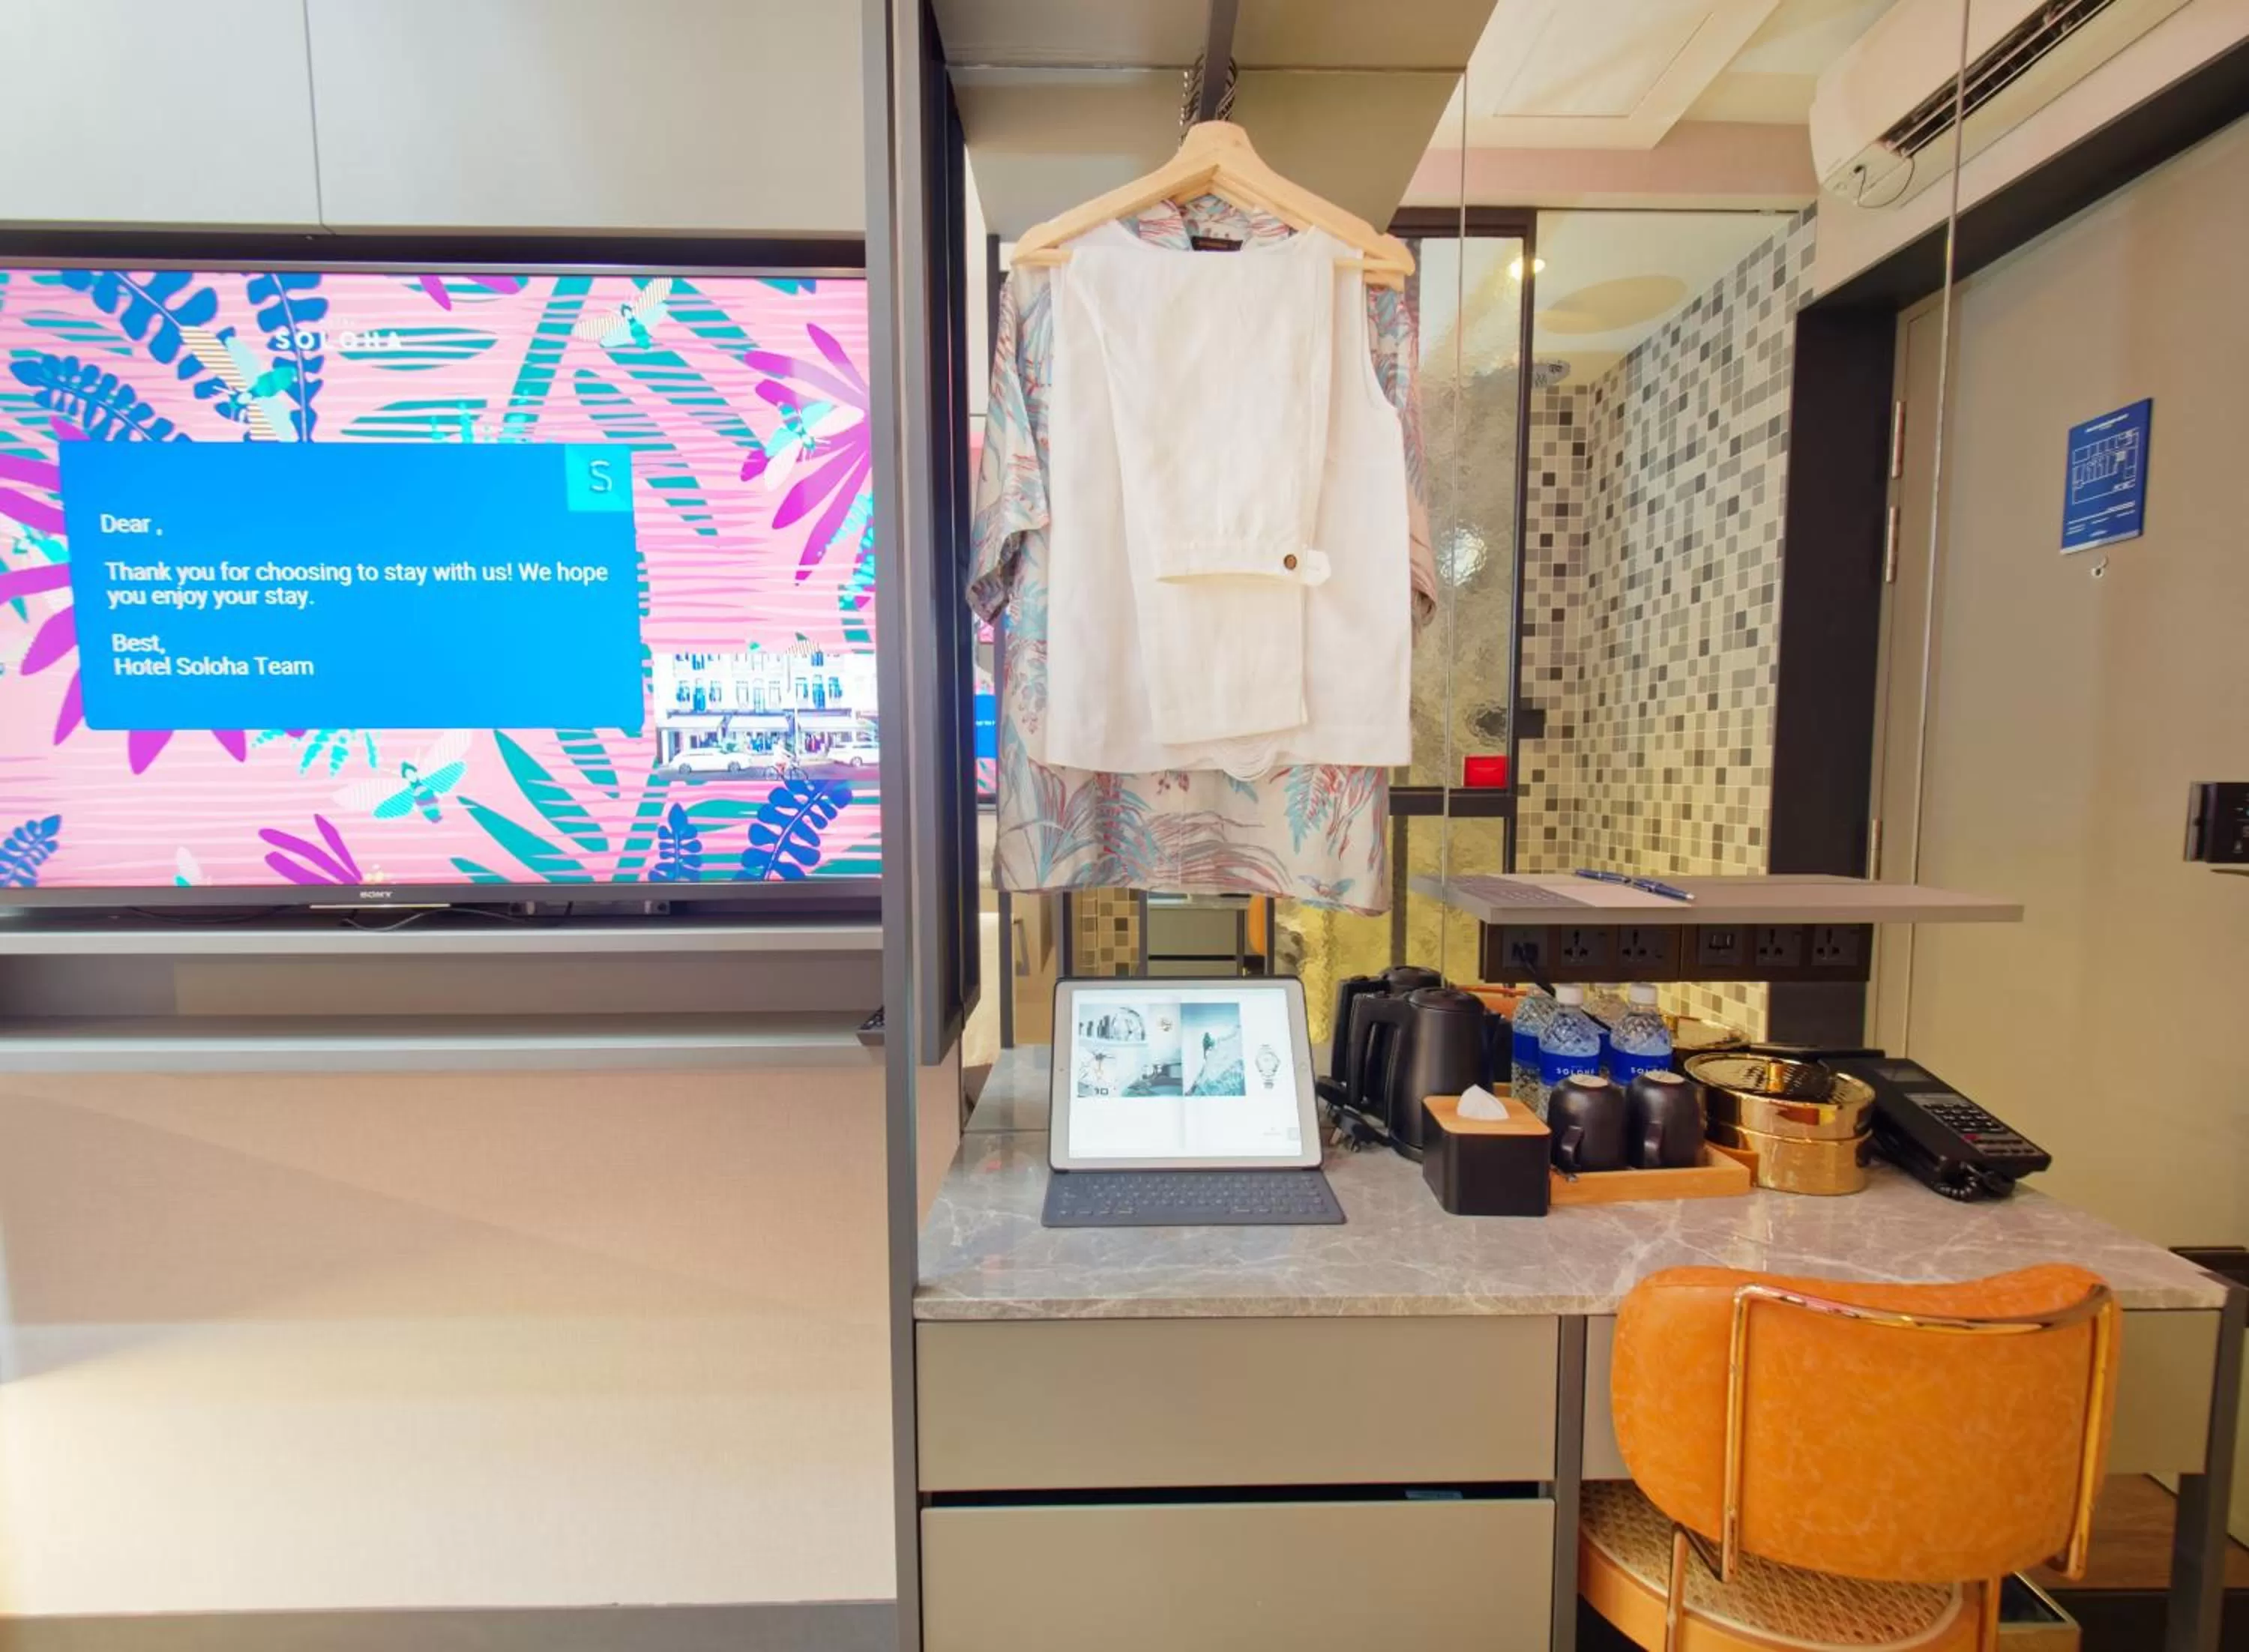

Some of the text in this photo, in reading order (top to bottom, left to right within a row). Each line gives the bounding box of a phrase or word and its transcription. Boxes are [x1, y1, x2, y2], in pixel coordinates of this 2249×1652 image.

[275, 331, 402, 349] SOLOHA
[588, 459, 613, 494] S
[100, 513, 152, 534] Dear
[105, 561, 609, 586] Thank you for choosing to stay with us! We hope
[106, 587, 315, 610] you enjoy your stay.
[112, 633, 166, 654] Best,
[113, 656, 315, 675] Hotel Soloha Team
